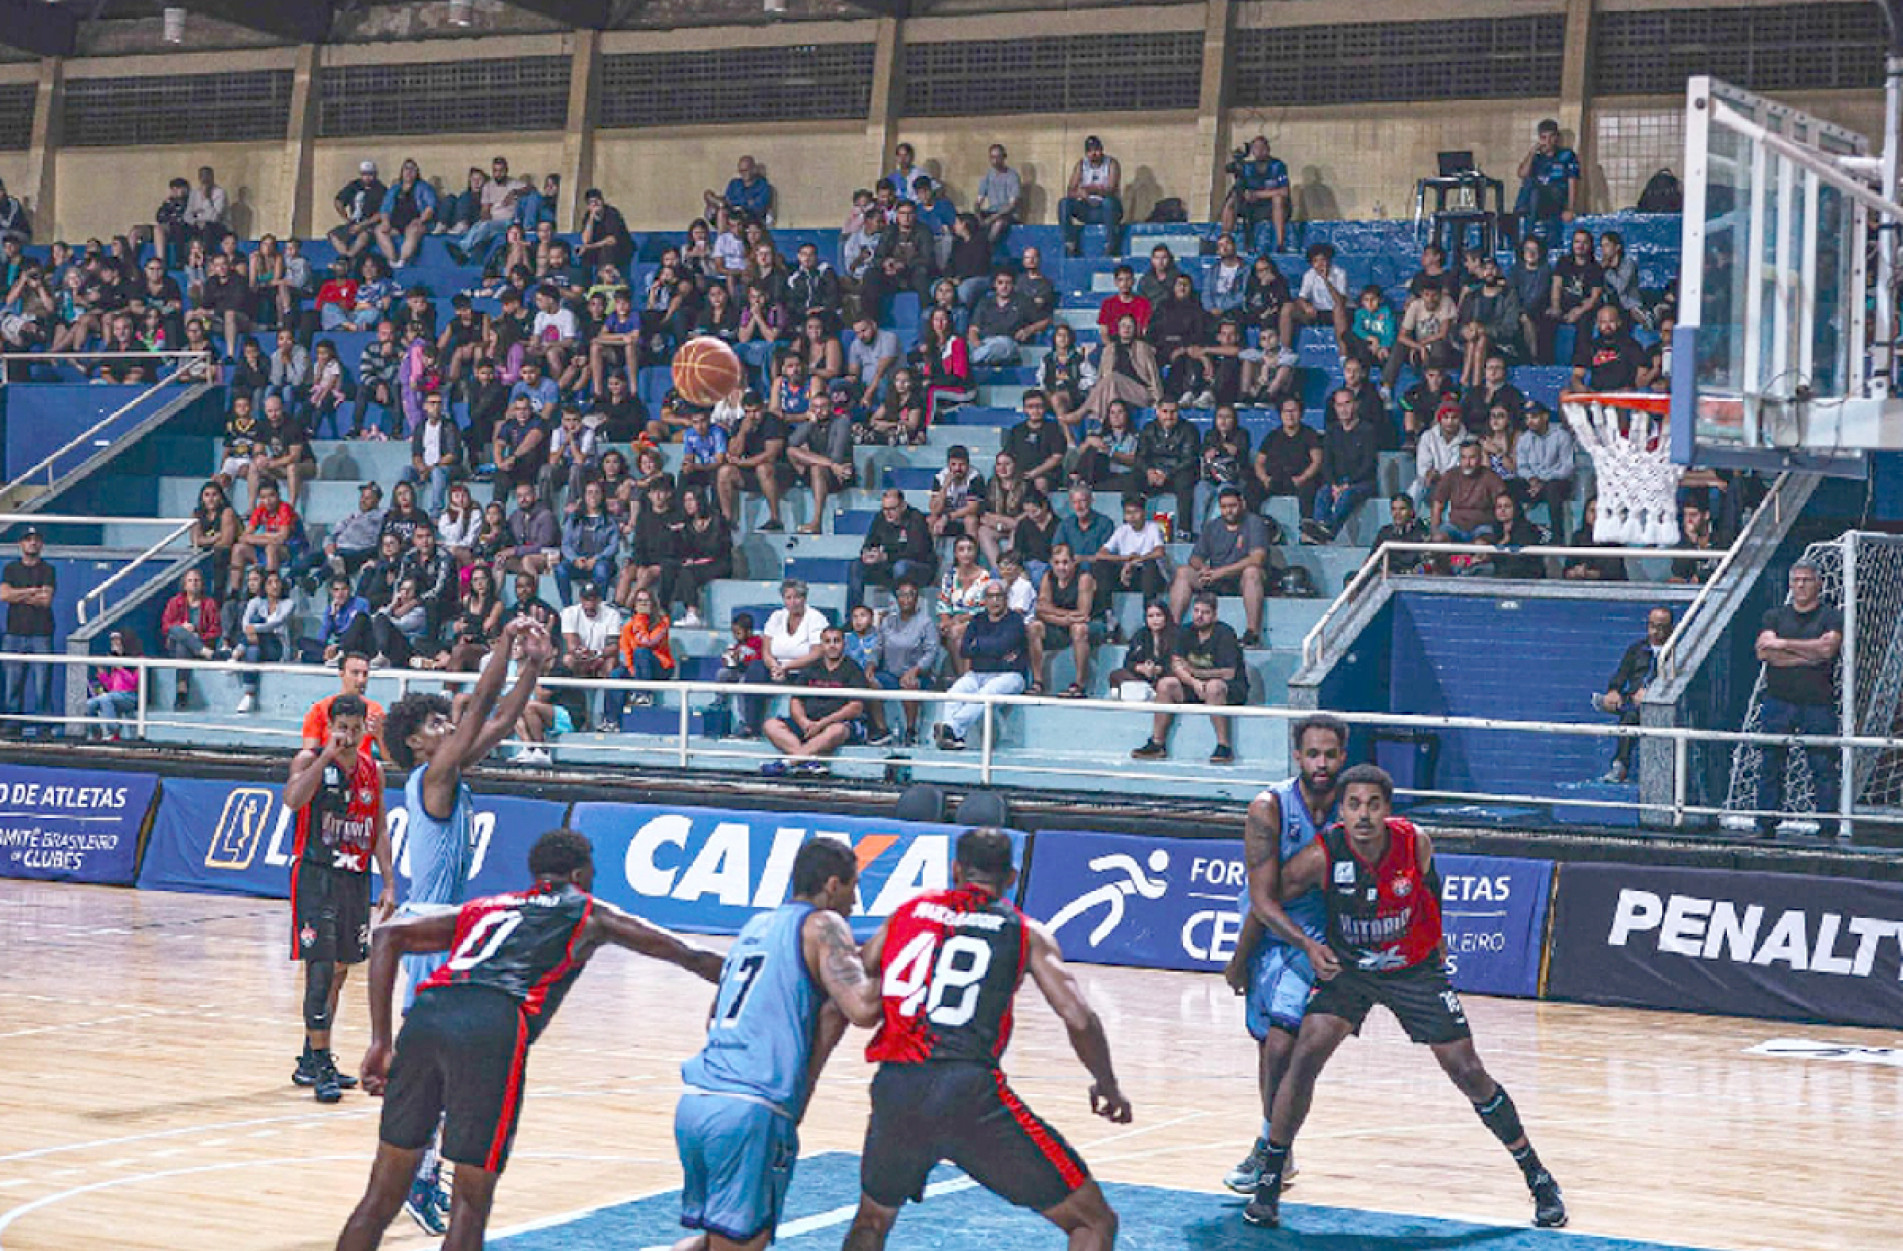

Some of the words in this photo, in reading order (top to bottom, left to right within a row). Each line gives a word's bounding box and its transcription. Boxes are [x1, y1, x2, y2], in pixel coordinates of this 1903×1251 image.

[11, 783, 40, 805] DE
[40, 786, 128, 808] ATLETAS
[24, 849, 86, 870] CLUBES
[1190, 857, 1248, 886] FOR
[1607, 888, 1903, 981] PENALT
[882, 929, 991, 1026] 48
